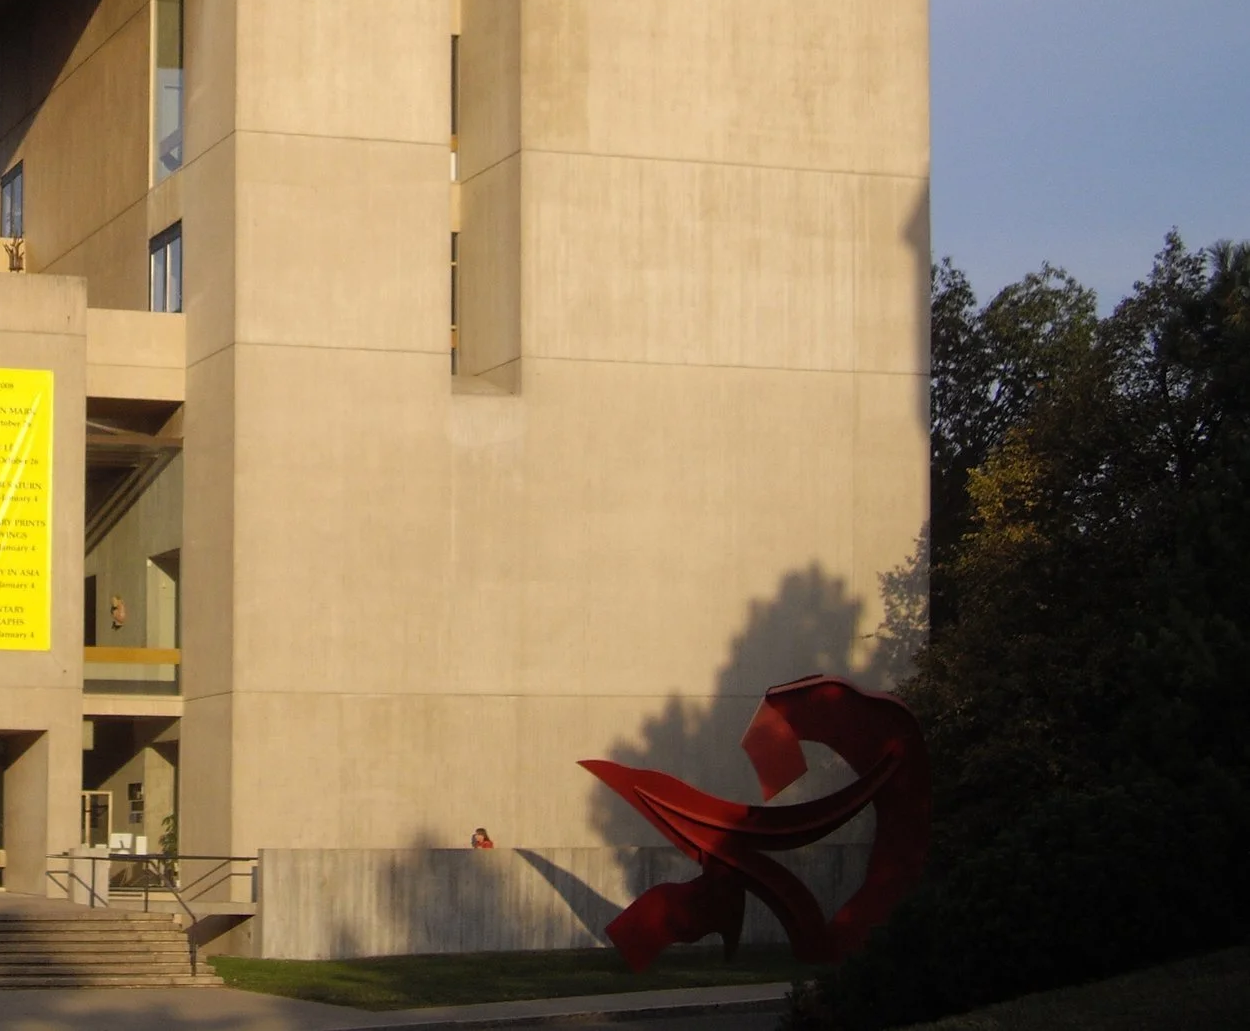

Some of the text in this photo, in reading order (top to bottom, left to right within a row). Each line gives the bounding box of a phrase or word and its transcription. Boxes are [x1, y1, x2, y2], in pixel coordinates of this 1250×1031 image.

[14, 519, 47, 528] PRINTS
[7, 568, 17, 576] IN
[20, 569, 40, 577] ASIA
